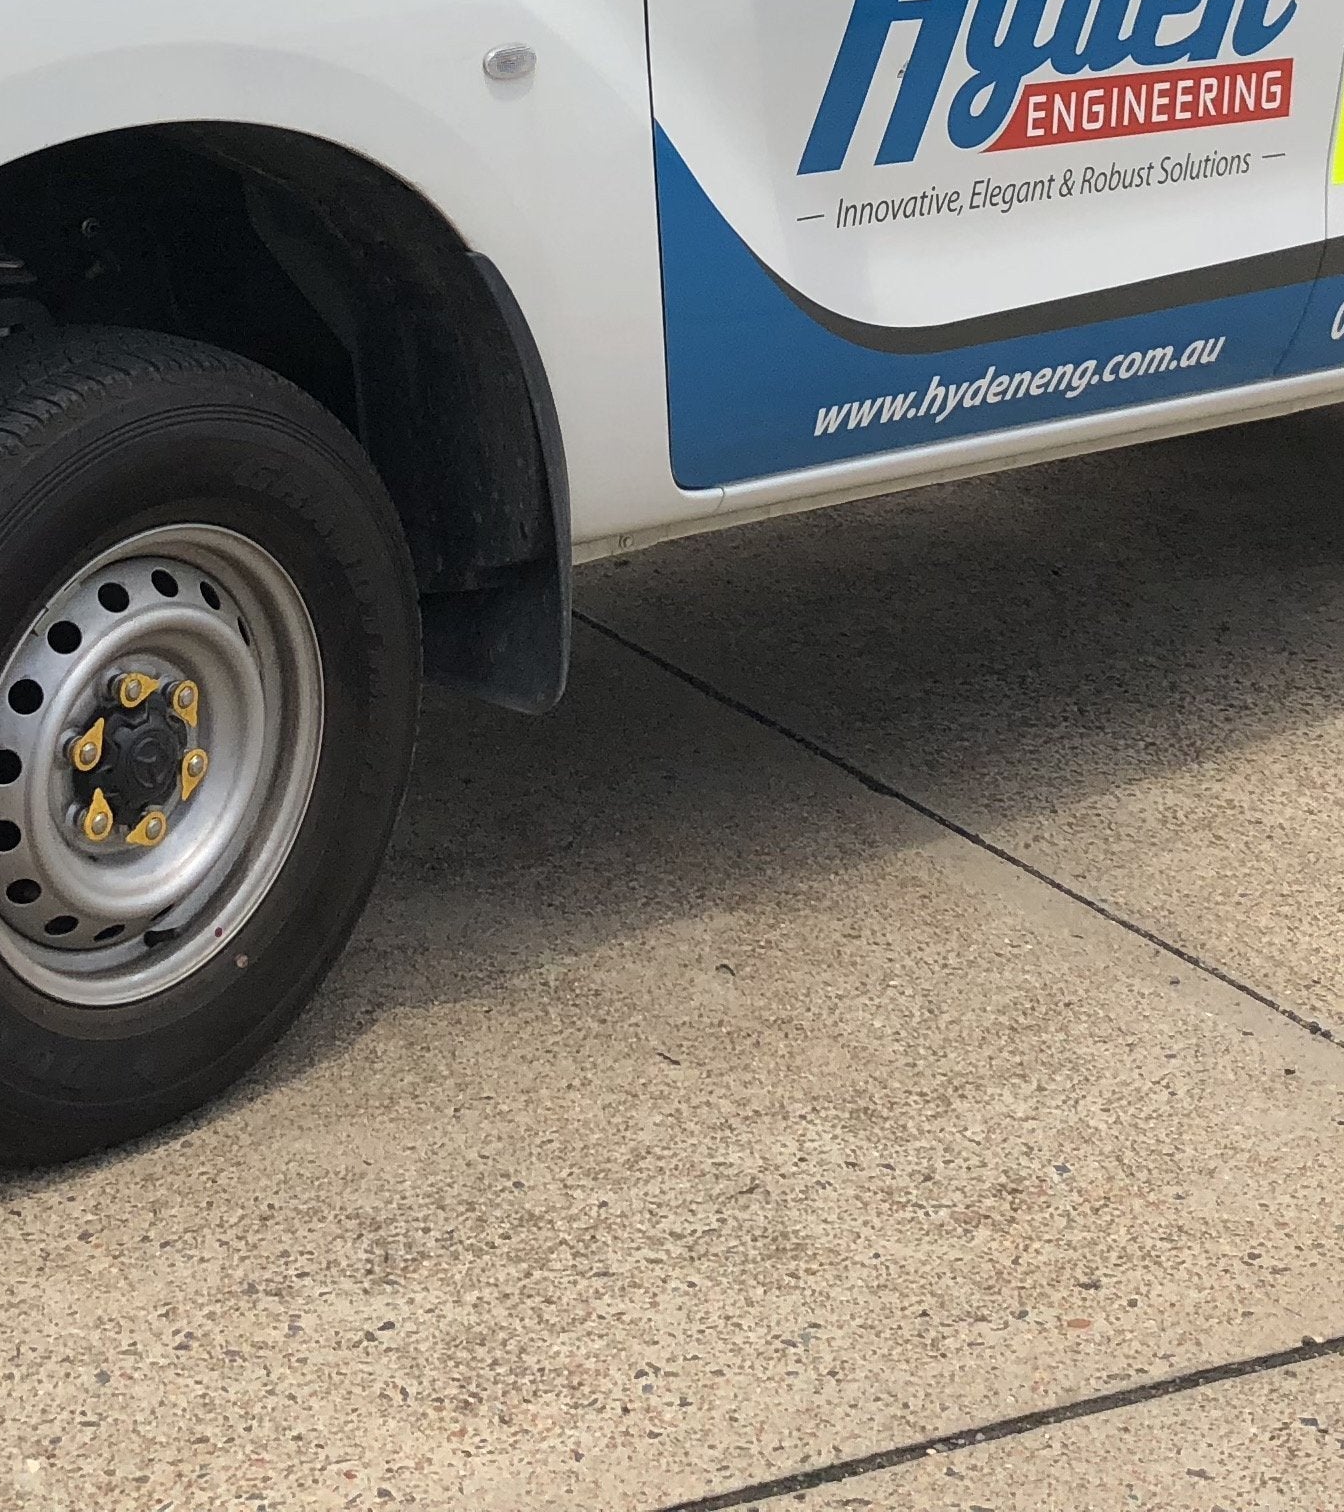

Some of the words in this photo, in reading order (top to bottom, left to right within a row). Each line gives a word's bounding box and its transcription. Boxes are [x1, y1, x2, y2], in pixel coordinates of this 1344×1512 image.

[1026, 69, 1283, 138] ENGINEERING
[835, 185, 963, 229] Innovative,
[968, 172, 1056, 214] Elegant
[1058, 169, 1075, 198] &
[1079, 161, 1155, 196] Robust
[1158, 149, 1252, 187] Solutions
[813, 333, 1226, 438] www.hydeneng.com.au
